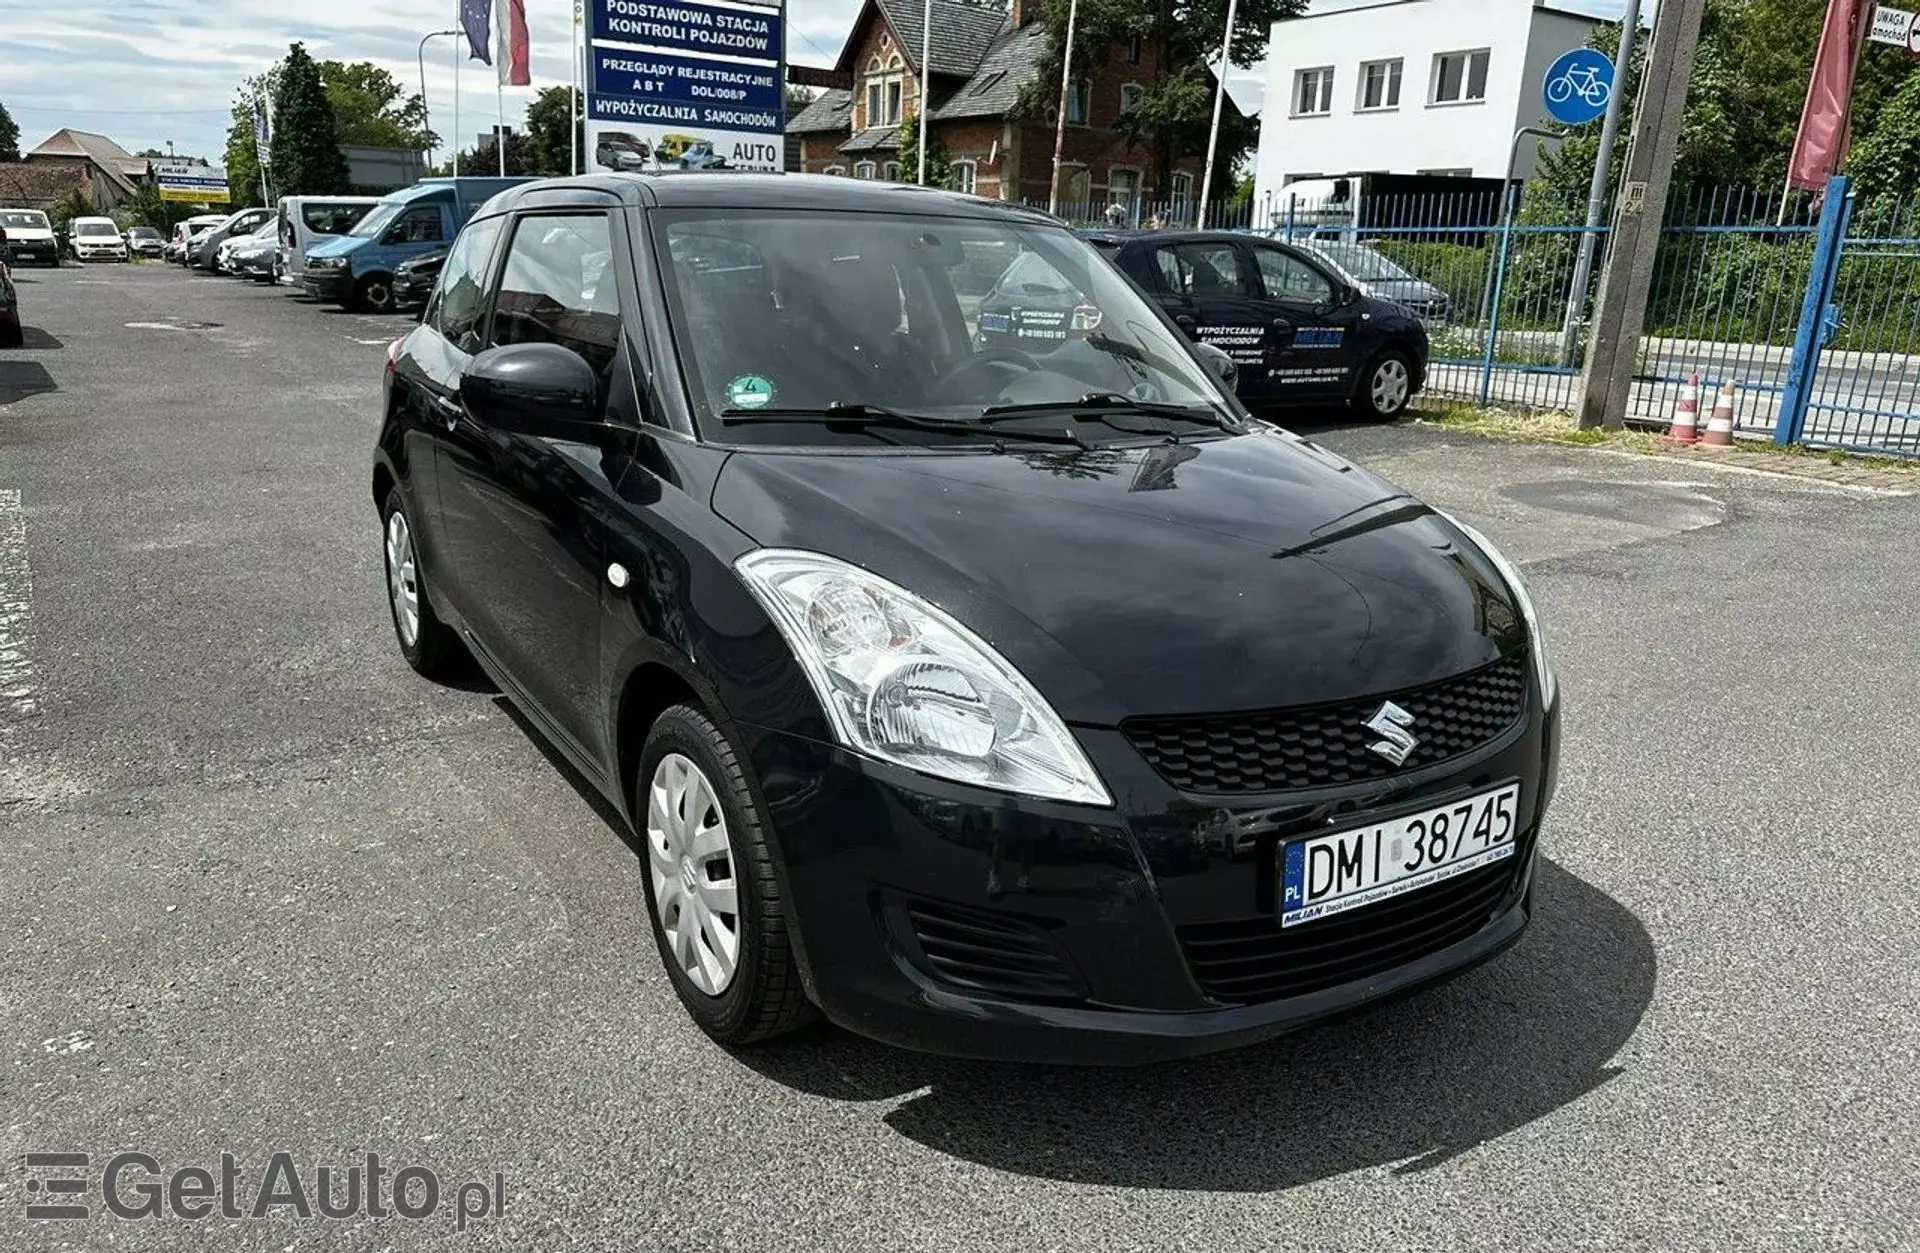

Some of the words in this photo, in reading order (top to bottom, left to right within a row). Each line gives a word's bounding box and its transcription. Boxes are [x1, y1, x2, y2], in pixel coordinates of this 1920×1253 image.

[607, 0, 713, 26] PODSTAWOWA
[716, 15, 769, 33] STACJA
[1877, 10, 1905, 26] UWAGA
[609, 17, 686, 40] KONTROLI
[690, 29, 768, 50] POJAZDÓW
[602, 58, 674, 77] PRZEGLĄDY
[677, 67, 773, 87] REJESTRACYJNE
[633, 79, 642, 90] A
[644, 80, 653, 91] B
[656, 81, 665, 92] T
[691, 85, 747, 100] DOL/008/P
[595, 99, 698, 120] WYPOŻYCZALNIA
[704, 109, 777, 127] SAMOCHODÓW
[733, 142, 776, 162] AUTO
[744, 379, 757, 392] 4
[1308, 829, 1383, 900] DMI
[1404, 791, 1514, 872] 38745
[1285, 885, 1301, 903] PL
[1284, 906, 1324, 925] MILIAN
